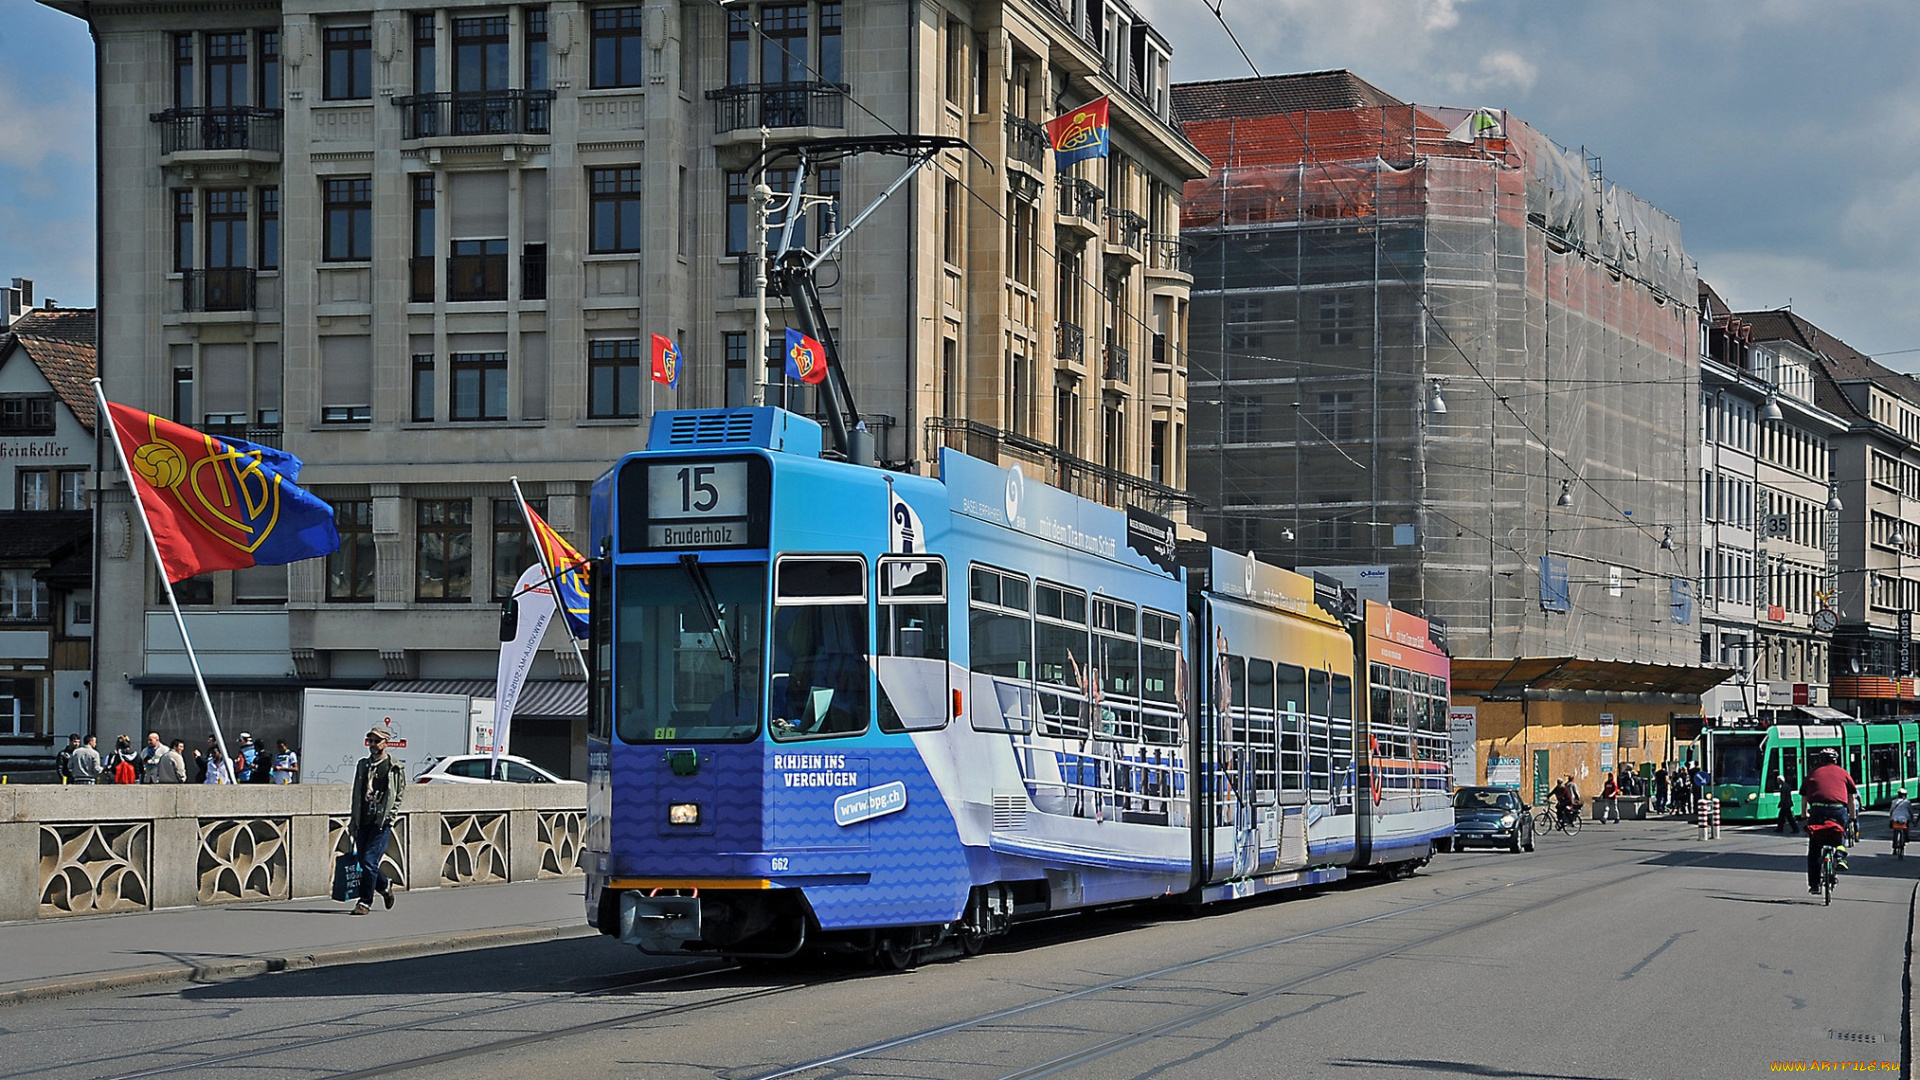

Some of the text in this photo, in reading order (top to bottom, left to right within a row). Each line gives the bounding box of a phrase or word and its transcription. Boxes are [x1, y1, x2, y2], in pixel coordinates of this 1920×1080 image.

[677, 466, 719, 512] 15
[1769, 518, 1788, 532] 35
[664, 526, 732, 545] Bruderholz
[1040, 516, 1116, 558] mit dem Tram zum Schiff
[1901, 612, 1910, 672] McDonald's
[774, 755, 845, 769] R(H)EIN INS
[784, 770, 857, 787] VERGNÜGEN
[840, 789, 900, 816] www.bpg.ch
[772, 858, 788, 870] 662
